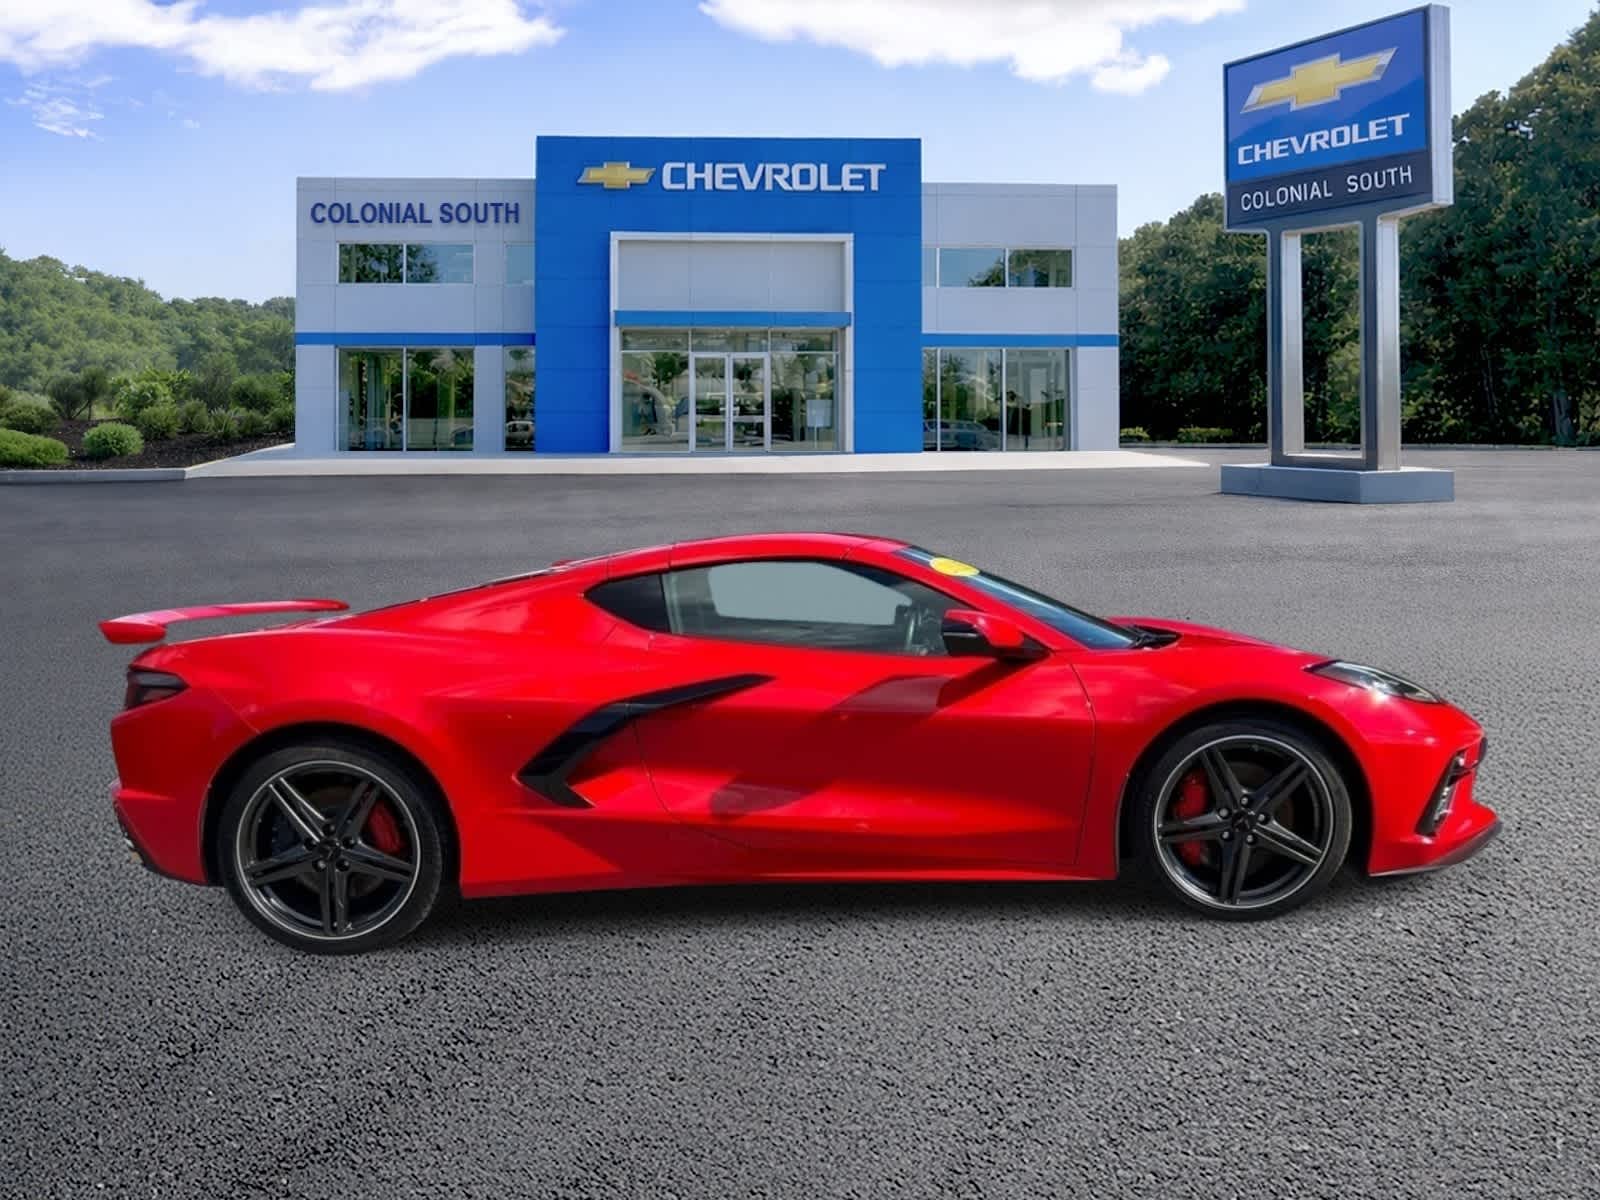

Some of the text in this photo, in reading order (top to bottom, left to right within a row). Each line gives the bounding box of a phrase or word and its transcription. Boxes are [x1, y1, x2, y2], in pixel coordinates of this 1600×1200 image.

[1237, 113, 1410, 165] CHEVROLET
[661, 161, 887, 192] CHEVROLET
[1240, 165, 1413, 211] COLONIAL SOUTH
[310, 202, 521, 224] COLONIAL SOUTH
